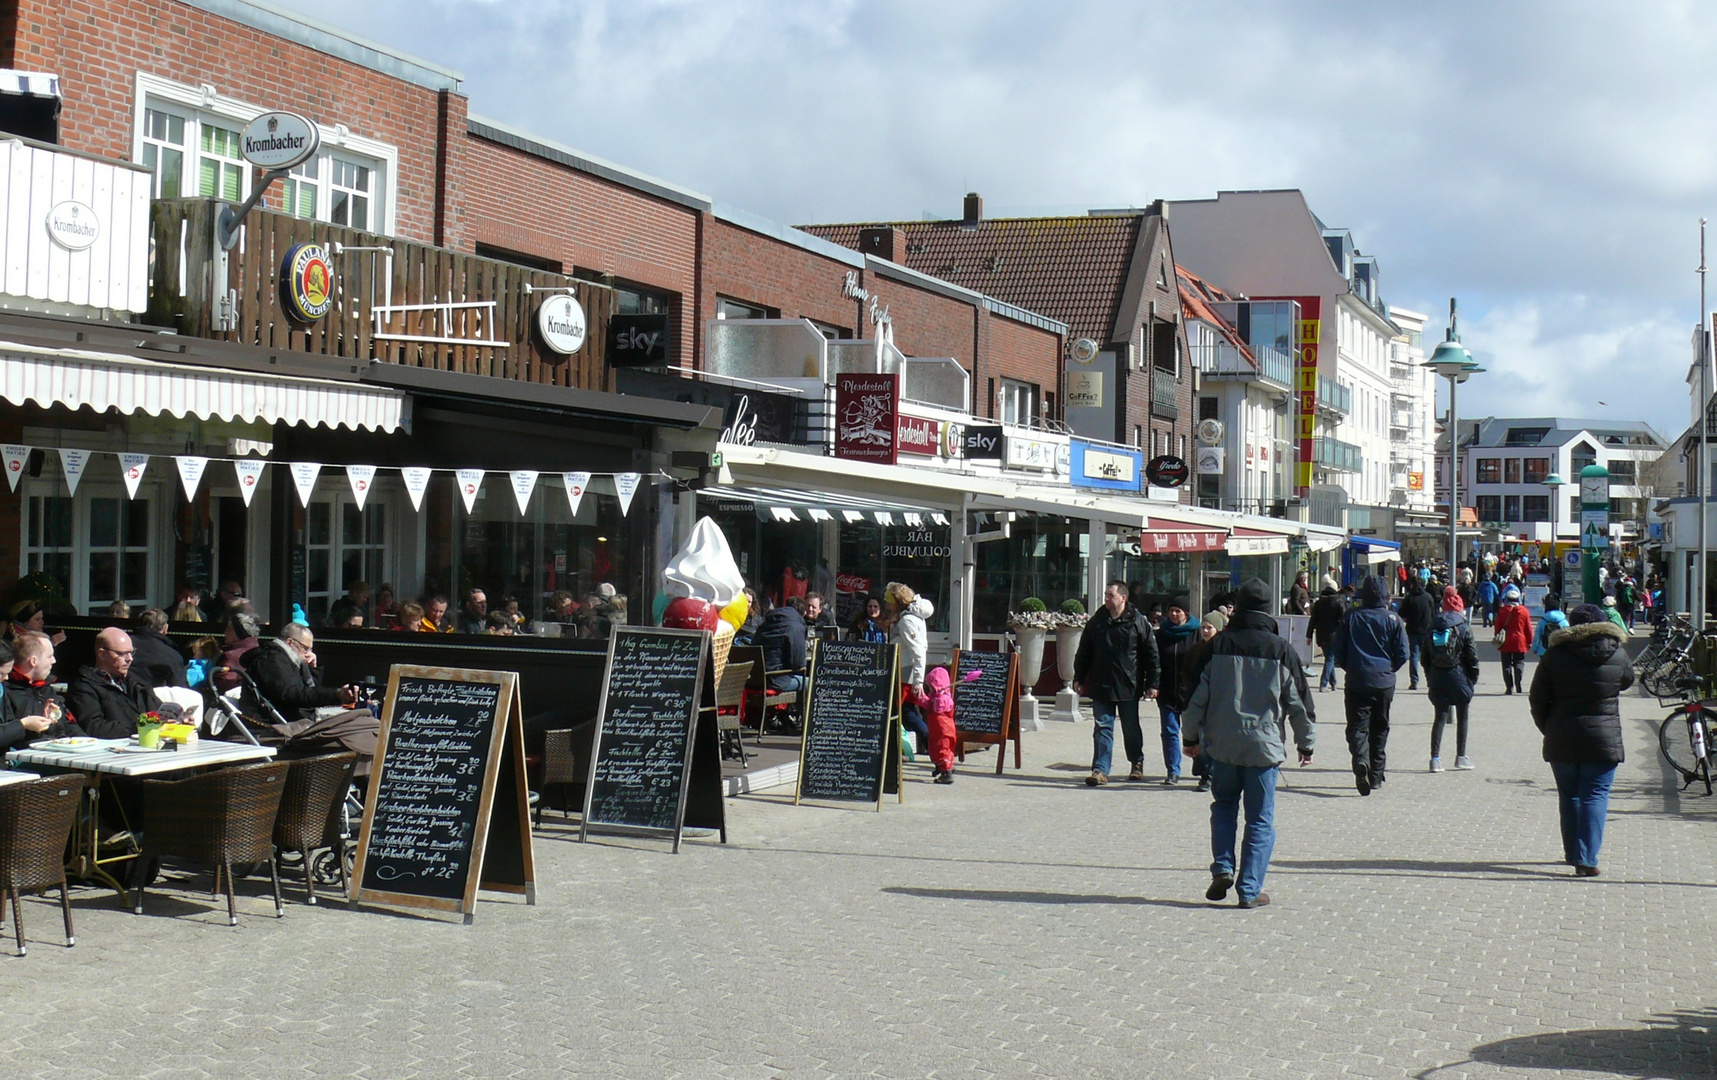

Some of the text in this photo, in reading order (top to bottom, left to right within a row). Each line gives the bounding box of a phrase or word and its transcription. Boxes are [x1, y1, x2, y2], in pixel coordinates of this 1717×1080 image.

[245, 132, 305, 154] Krombacher
[53, 216, 96, 237] Krombacher
[296, 247, 335, 276] PAULANER
[298, 293, 332, 316] MÜNCHEN
[547, 315, 584, 339] Krombacher
[616, 326, 659, 356] sky
[840, 380, 892, 394] Pferdestall
[1302, 328, 1317, 436] HOTEL
[897, 416, 930, 450] ferdestall
[967, 432, 998, 452] sky
[718, 504, 754, 512] ESPRESSO
[638, 637, 670, 650] Gambas
